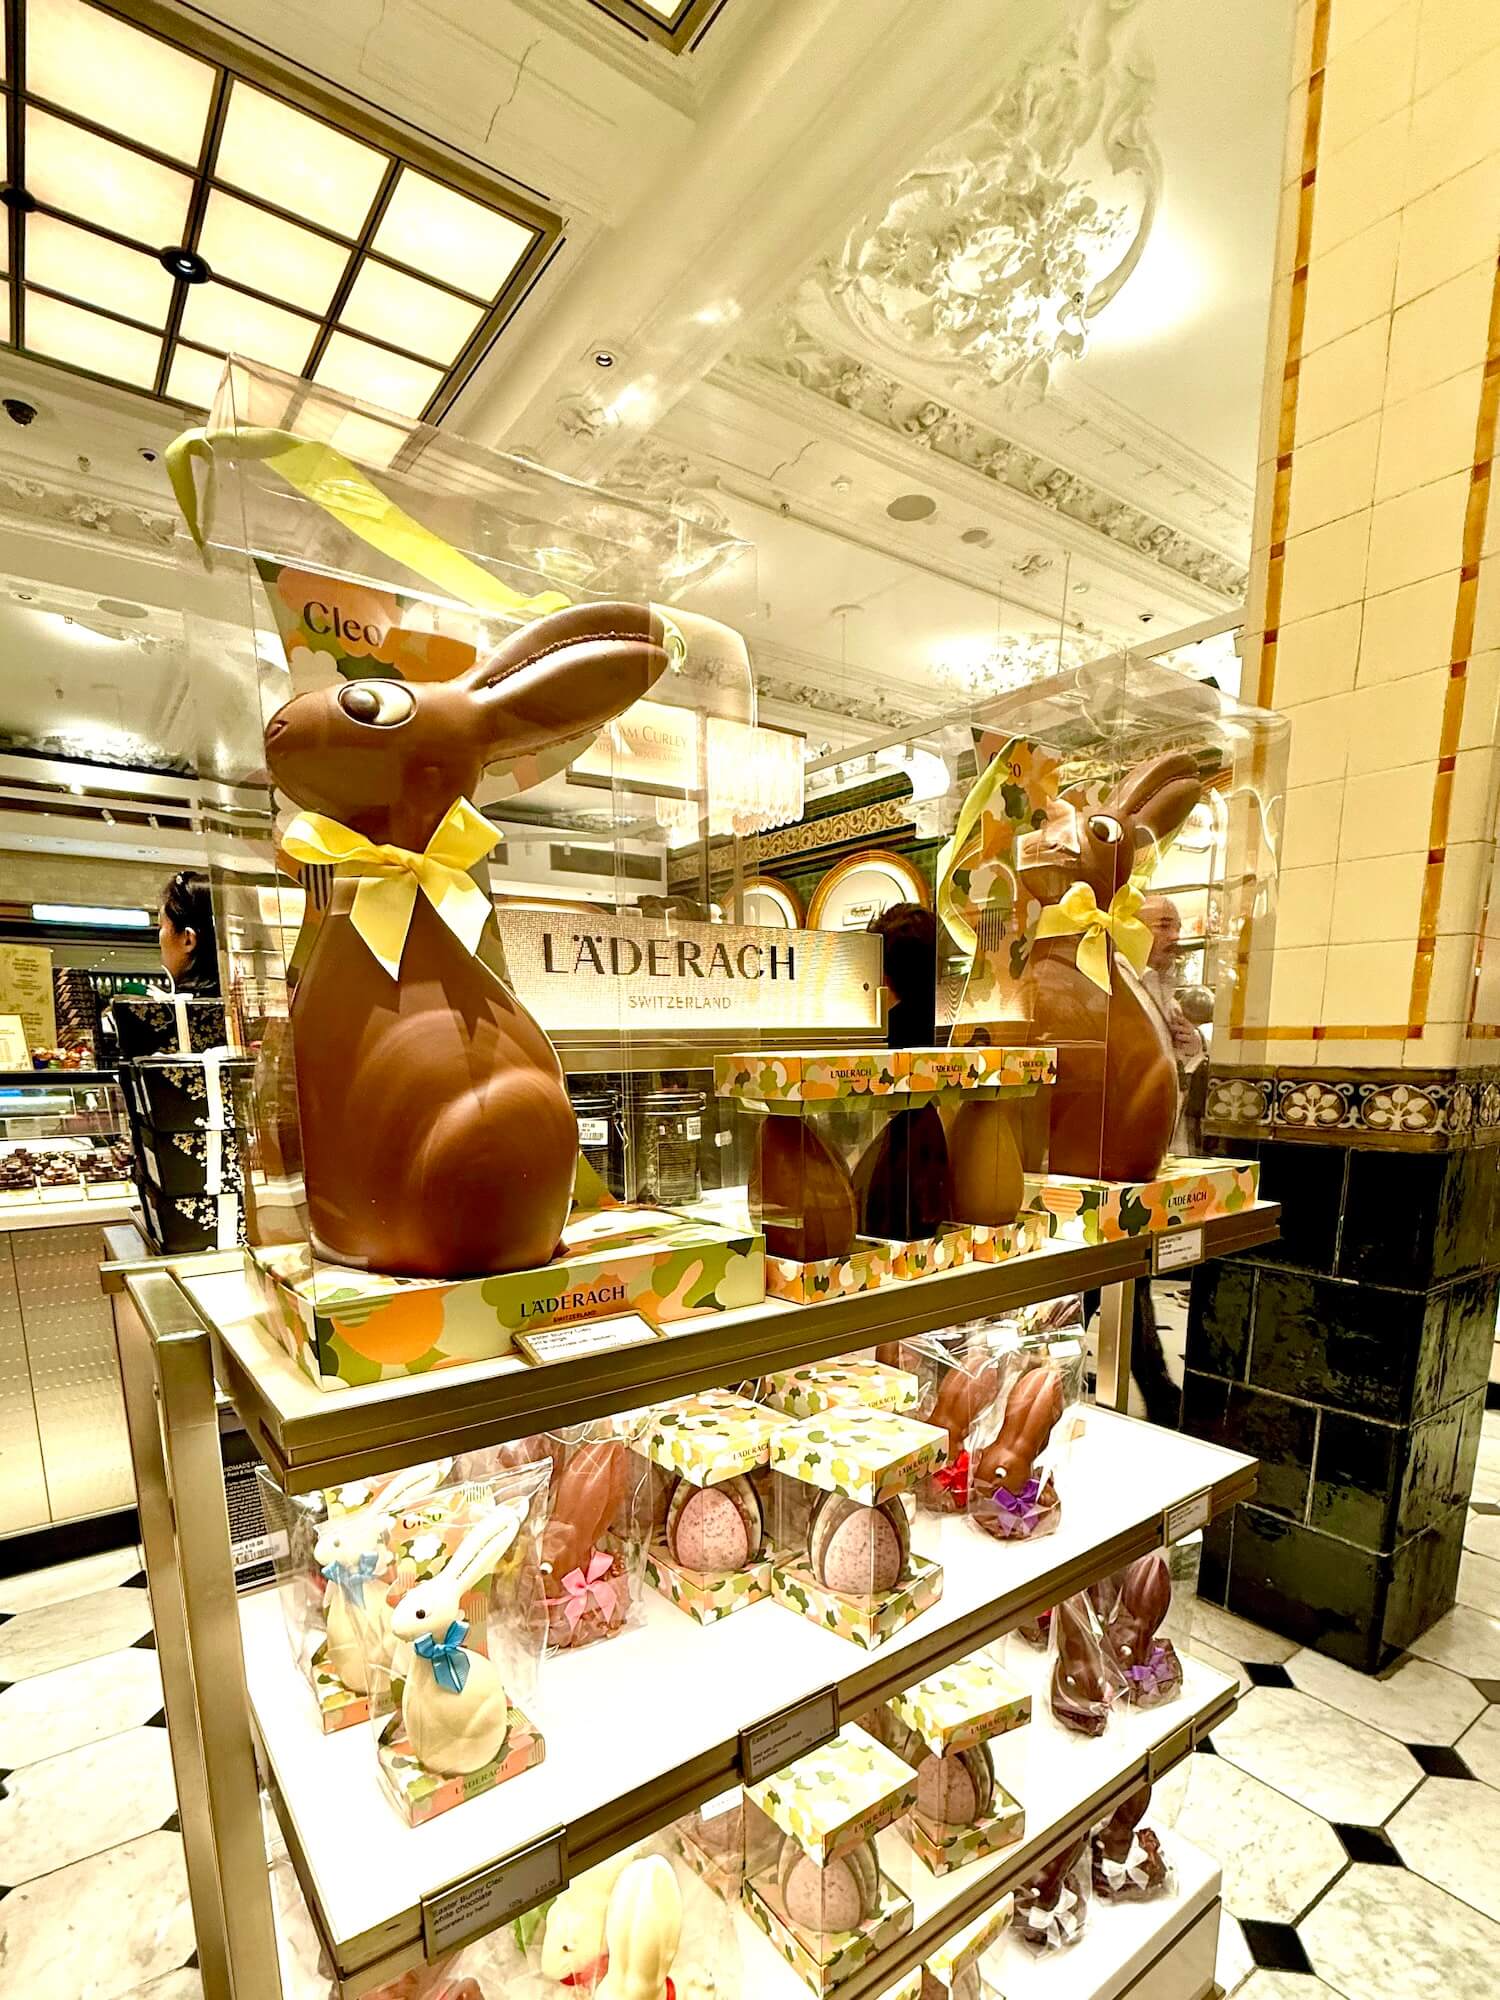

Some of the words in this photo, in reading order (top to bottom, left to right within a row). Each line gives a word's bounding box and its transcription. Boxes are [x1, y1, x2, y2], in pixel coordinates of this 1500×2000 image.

[303, 601, 383, 647] Cleo
[642, 725, 689, 747] CURLEY
[543, 933, 795, 980] LÄDERACH
[628, 996, 732, 1009] SWITZERLAND
[520, 1285, 625, 1318] LÄDERACH
[552, 1310, 598, 1323] SWITZERLAND
[432, 1900, 458, 1918] Easter
[460, 1885, 485, 1904] Bunny
[485, 1876, 504, 1889] Cleo
[455, 1890, 493, 1914] chocolate
